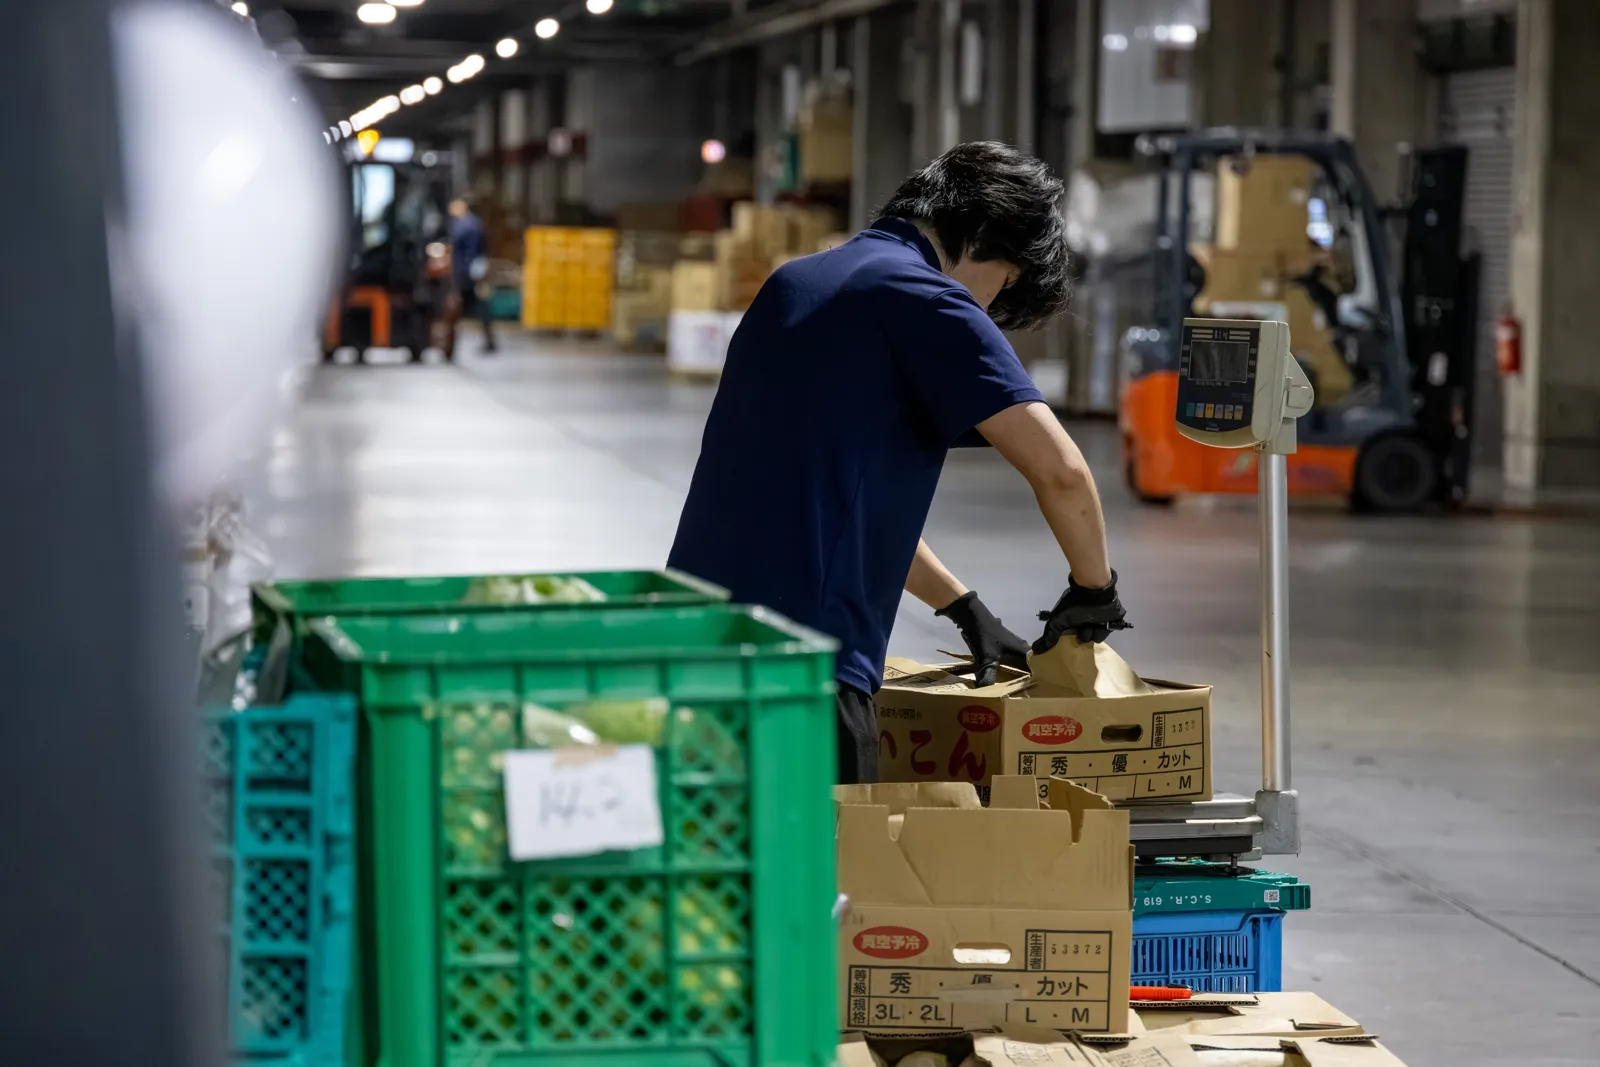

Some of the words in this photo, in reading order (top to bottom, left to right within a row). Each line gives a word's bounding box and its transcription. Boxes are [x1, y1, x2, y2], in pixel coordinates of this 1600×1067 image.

[1028, 722, 1077, 737] 真空予冷
[1153, 715, 1163, 747] 生産者
[1051, 756, 1068, 776] 秀
[1111, 753, 1129, 773] 優
[1157, 749, 1191, 769] カット
[1143, 896, 1163, 906] 619
[1169, 894, 1212, 905] S.C.R.
[861, 934, 920, 950] 真空予冷
[1029, 933, 1043, 970] 生産者
[1051, 943, 1102, 955] 53372
[854, 969, 867, 995] 等級
[889, 972, 912, 994] 秀
[1036, 975, 1089, 996] カット
[852, 998, 866, 1024] 規格
